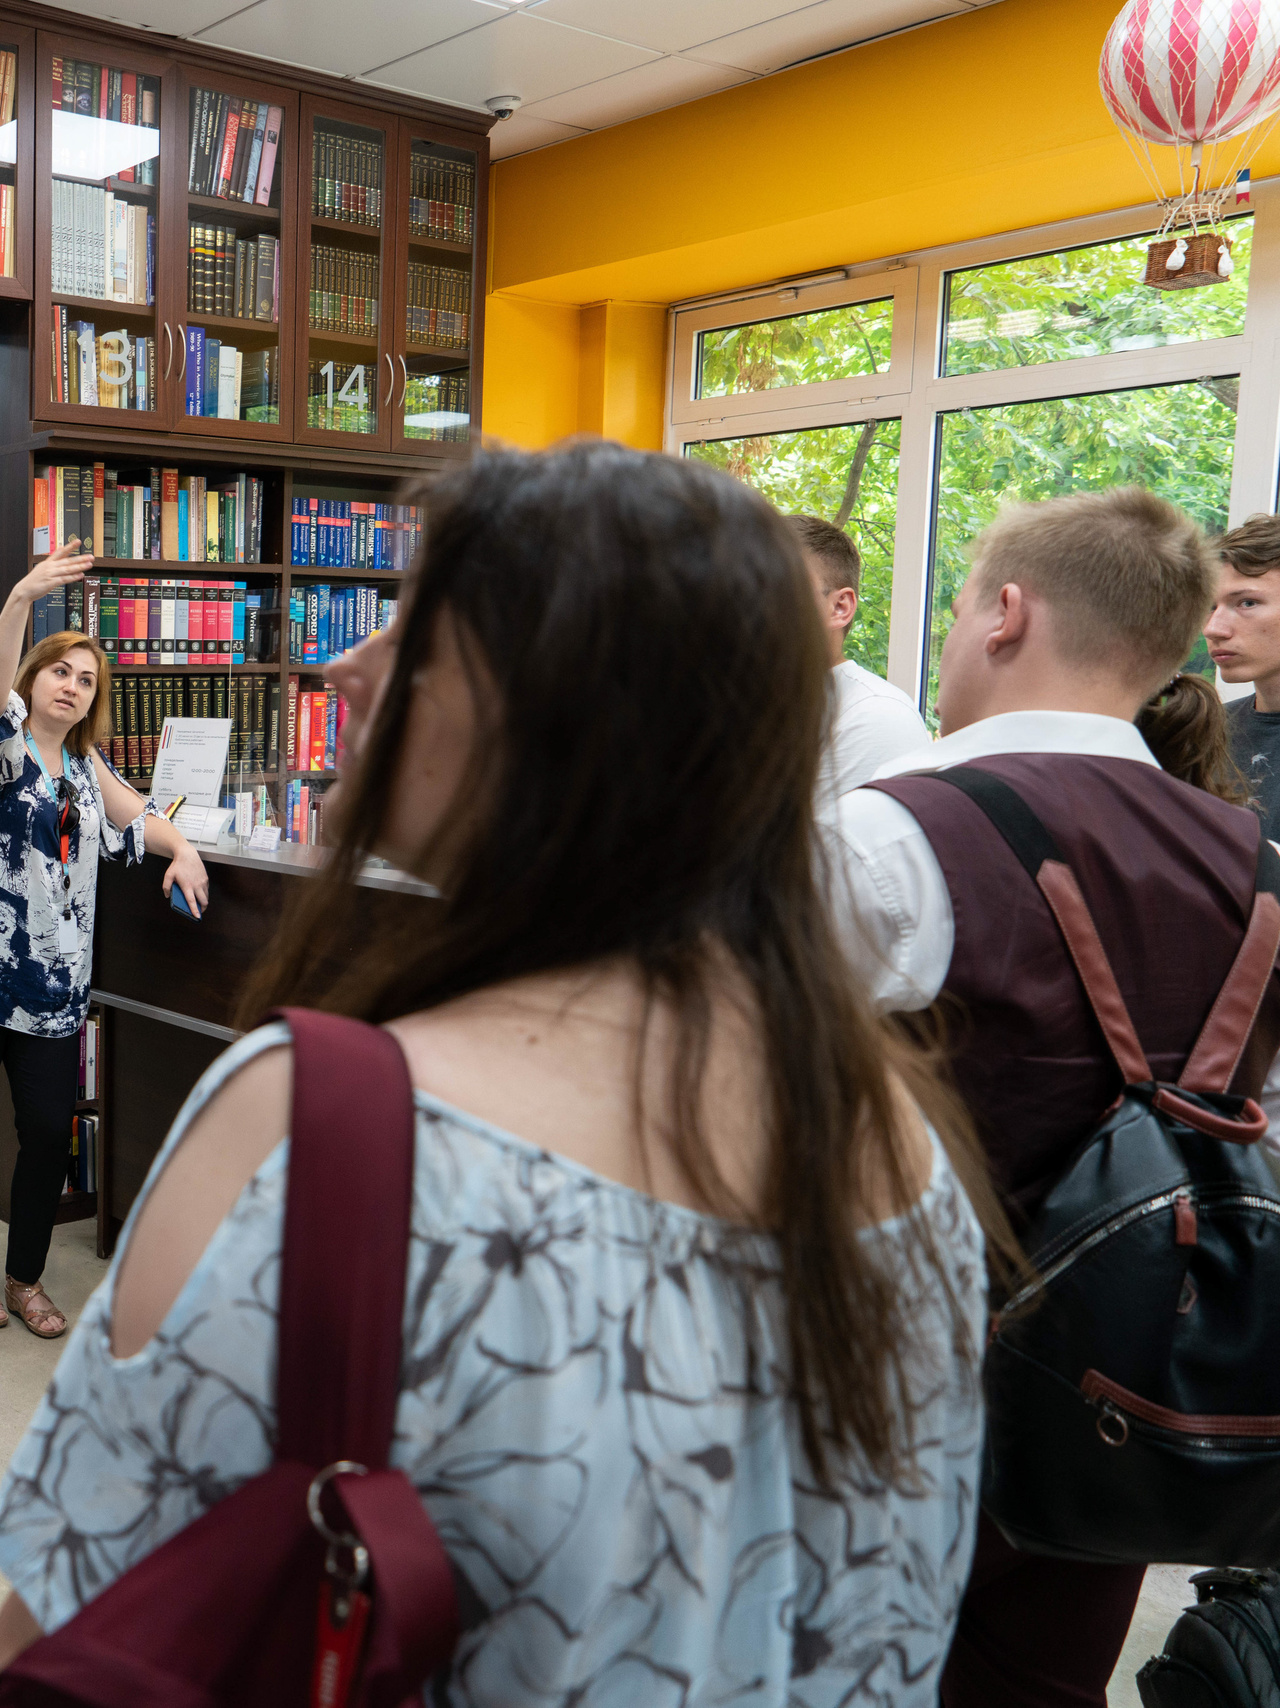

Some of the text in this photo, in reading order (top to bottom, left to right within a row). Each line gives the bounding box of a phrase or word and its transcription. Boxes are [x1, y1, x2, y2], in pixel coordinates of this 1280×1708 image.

[226, 116, 234, 143] SOVIET
[76, 329, 133, 385] 13
[320, 360, 369, 411] 14
[287, 698, 296, 756] DICTIONARY
